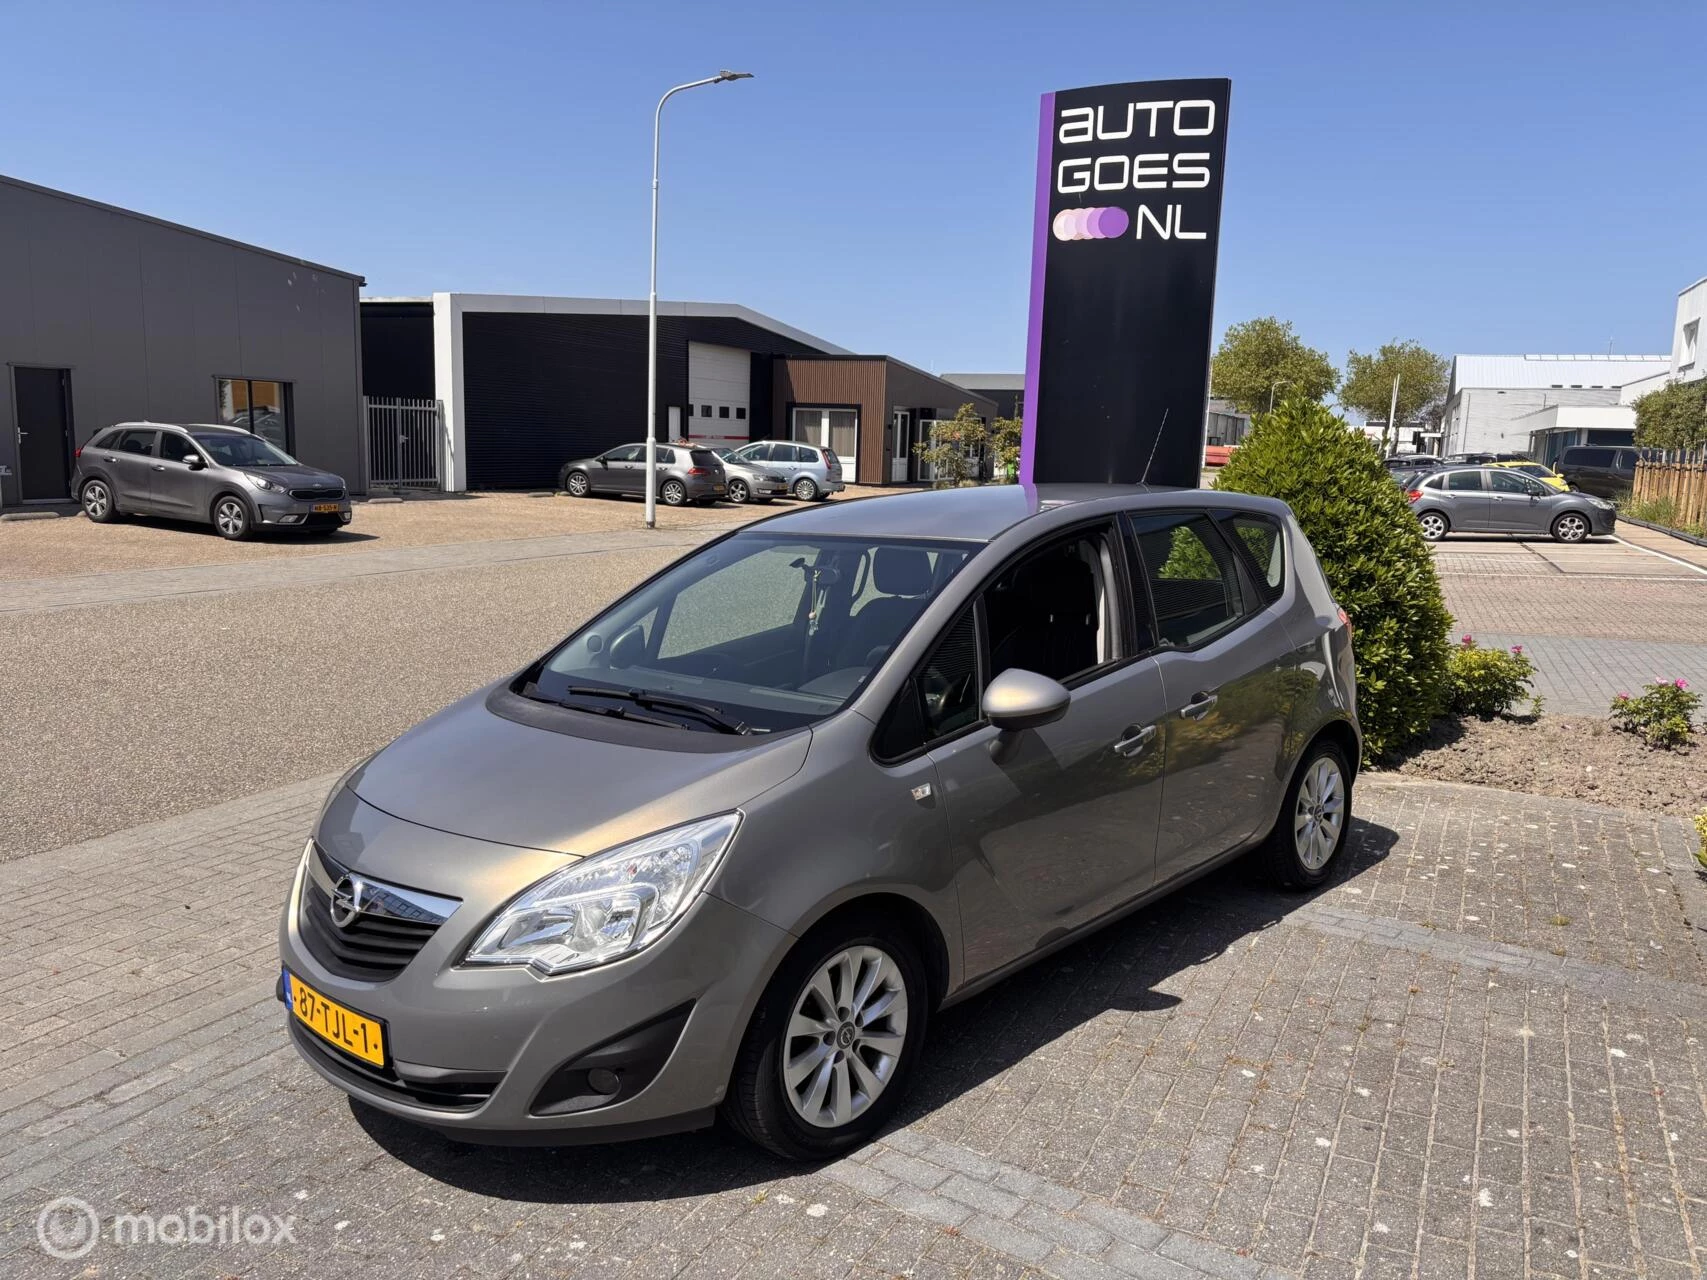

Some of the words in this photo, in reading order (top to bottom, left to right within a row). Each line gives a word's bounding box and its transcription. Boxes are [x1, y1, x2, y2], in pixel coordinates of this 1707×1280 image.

[1057, 152, 1211, 194] GOES
[1136, 204, 1207, 241] NL
[299, 986, 369, 1054] 87-TJL-1
